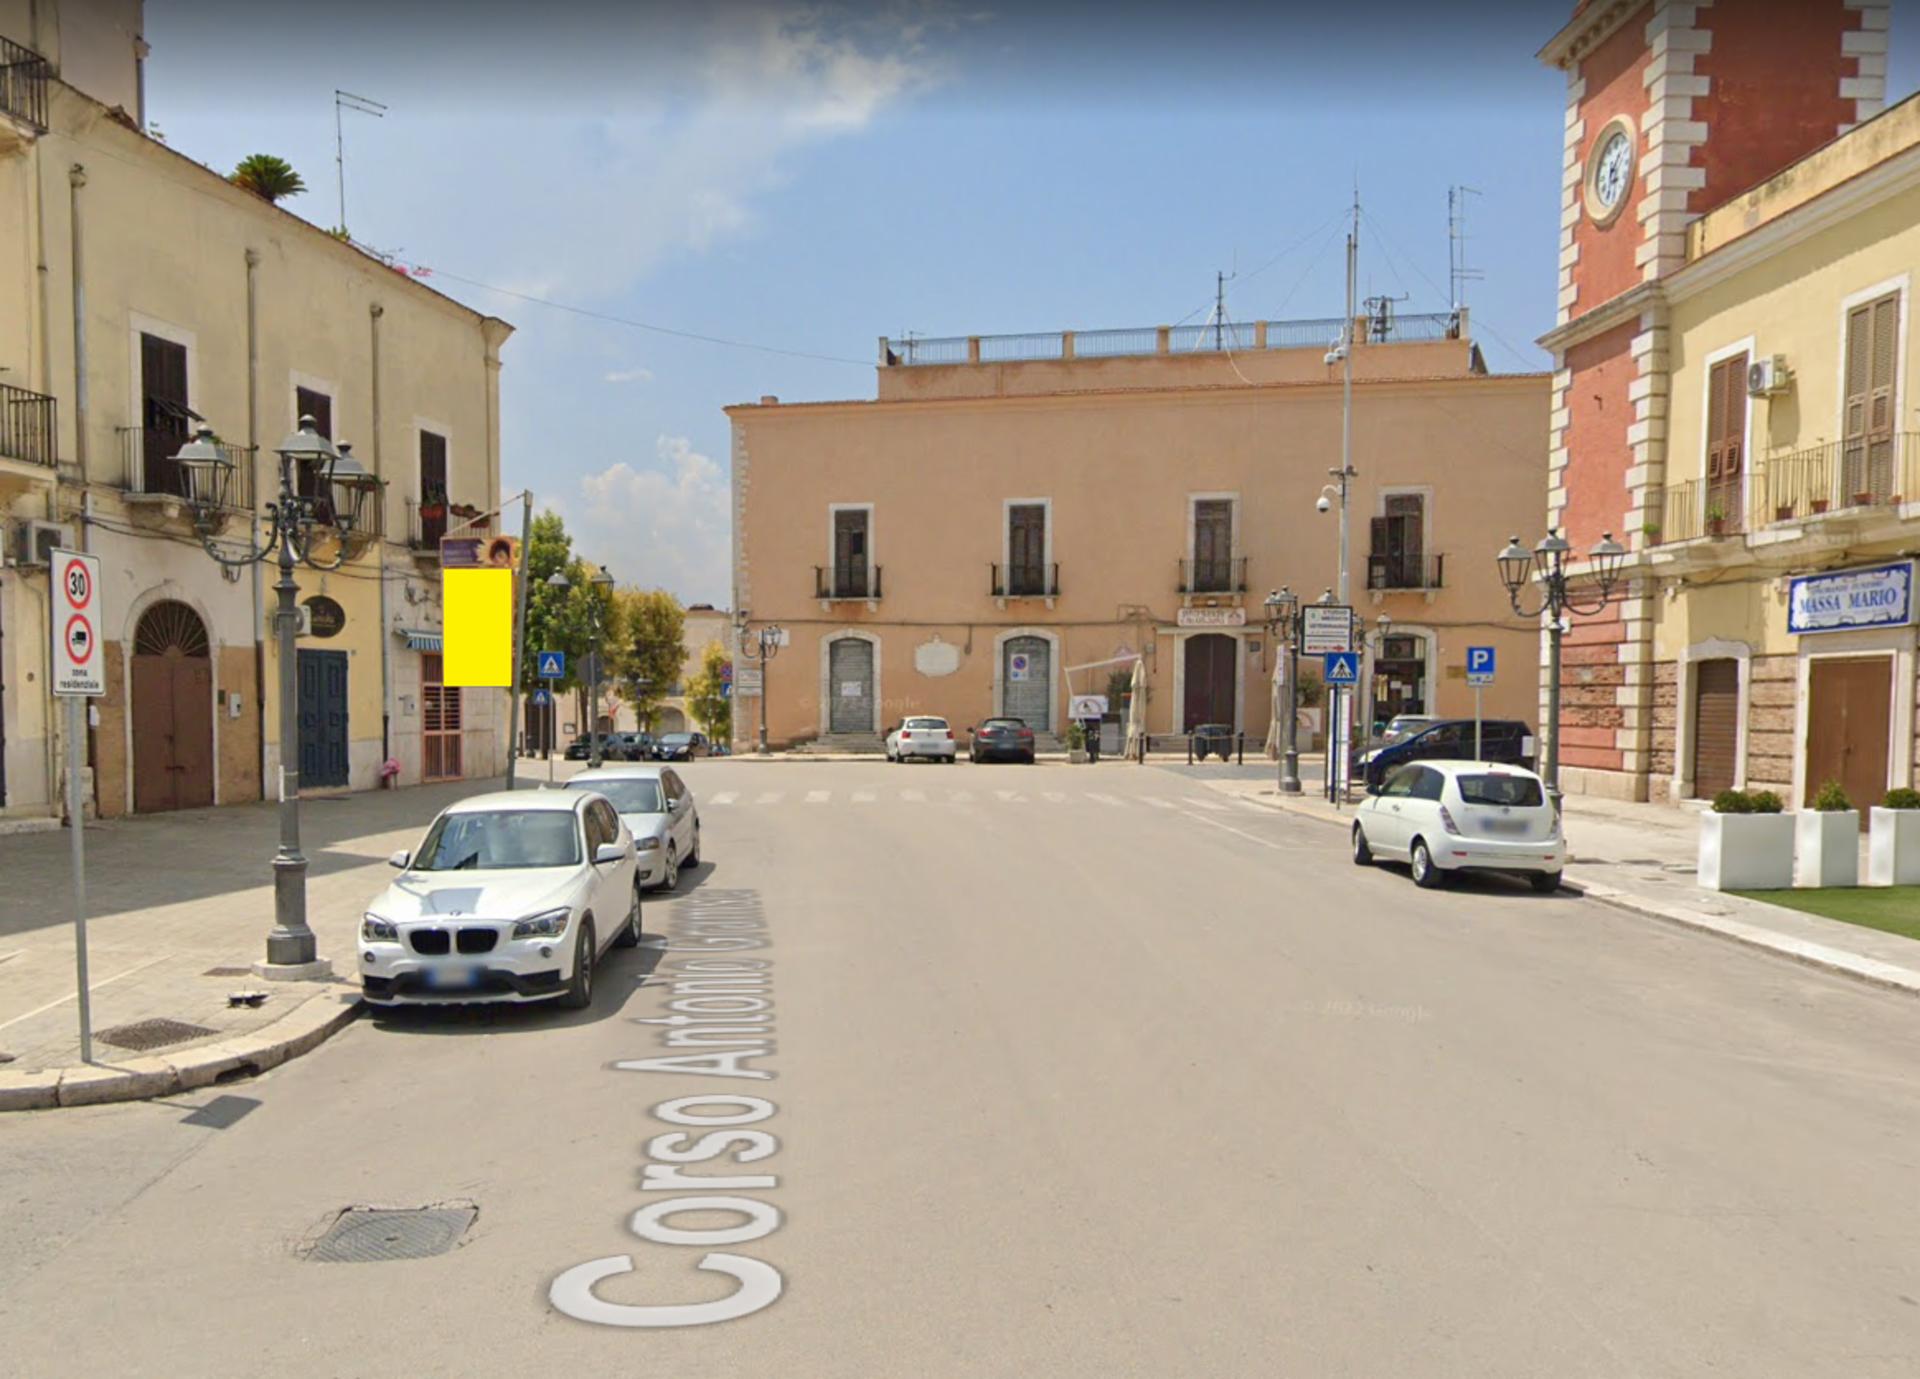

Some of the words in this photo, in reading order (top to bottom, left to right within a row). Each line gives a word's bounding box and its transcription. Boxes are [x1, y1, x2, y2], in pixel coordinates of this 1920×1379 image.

[70, 572, 85, 596] 30
[1800, 595, 1841, 614] MASSA
[1848, 587, 1897, 609] MARIO
[1472, 650, 1489, 669] P
[59, 679, 99, 689] residenziale
